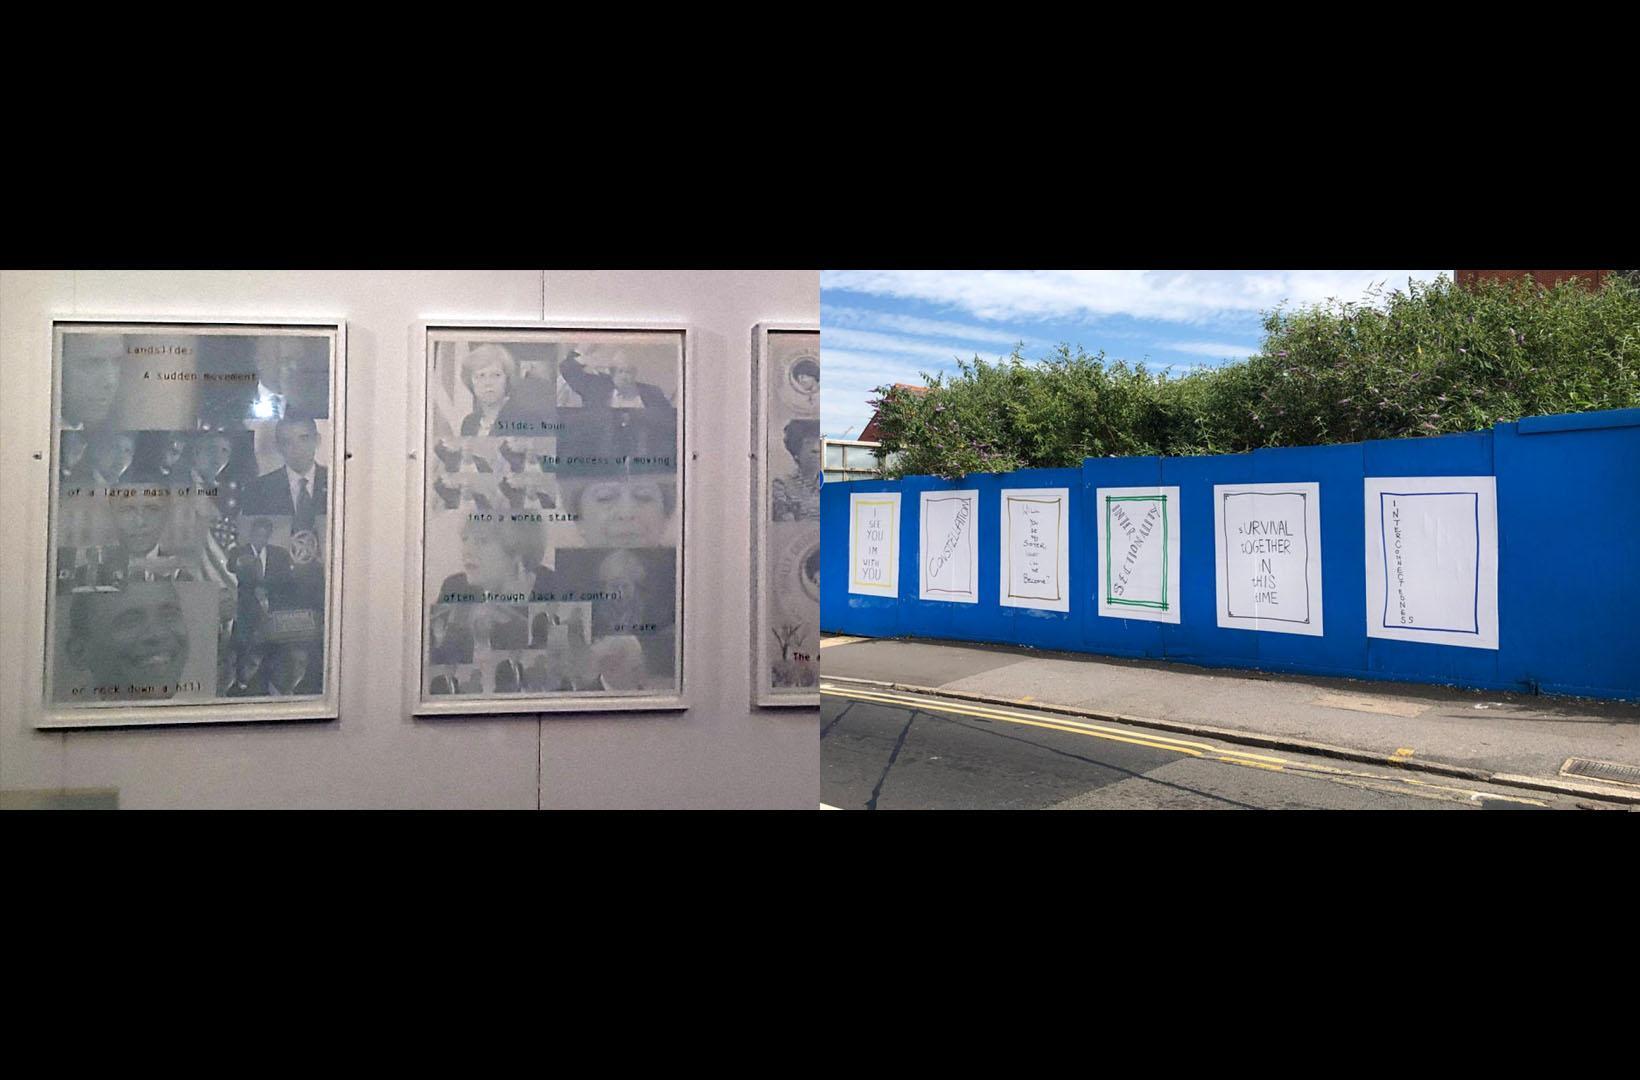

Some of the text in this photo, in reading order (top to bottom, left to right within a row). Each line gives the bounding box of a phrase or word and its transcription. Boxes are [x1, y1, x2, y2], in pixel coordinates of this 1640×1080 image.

[143, 371, 257, 380] A sudden movement
[541, 420, 566, 430] Noun
[543, 455, 670, 466] The process of moving
[67, 487, 80, 496] of
[104, 487, 136, 499] large
[178, 487, 190, 496] of
[197, 486, 218, 496] mud
[468, 513, 492, 522] into
[511, 514, 542, 522] worse
[548, 513, 579, 521] state
[869, 520, 881, 528] SEE
[867, 530, 883, 541] YOU
[1258, 558, 1271, 574] IN
[862, 568, 881, 581] YOU
[443, 590, 623, 602] often through lack of control
[793, 652, 810, 662] The
[72, 686, 85, 695] or
[93, 683, 120, 694] rock
[127, 683, 154, 693] down
[175, 681, 201, 693] hill
